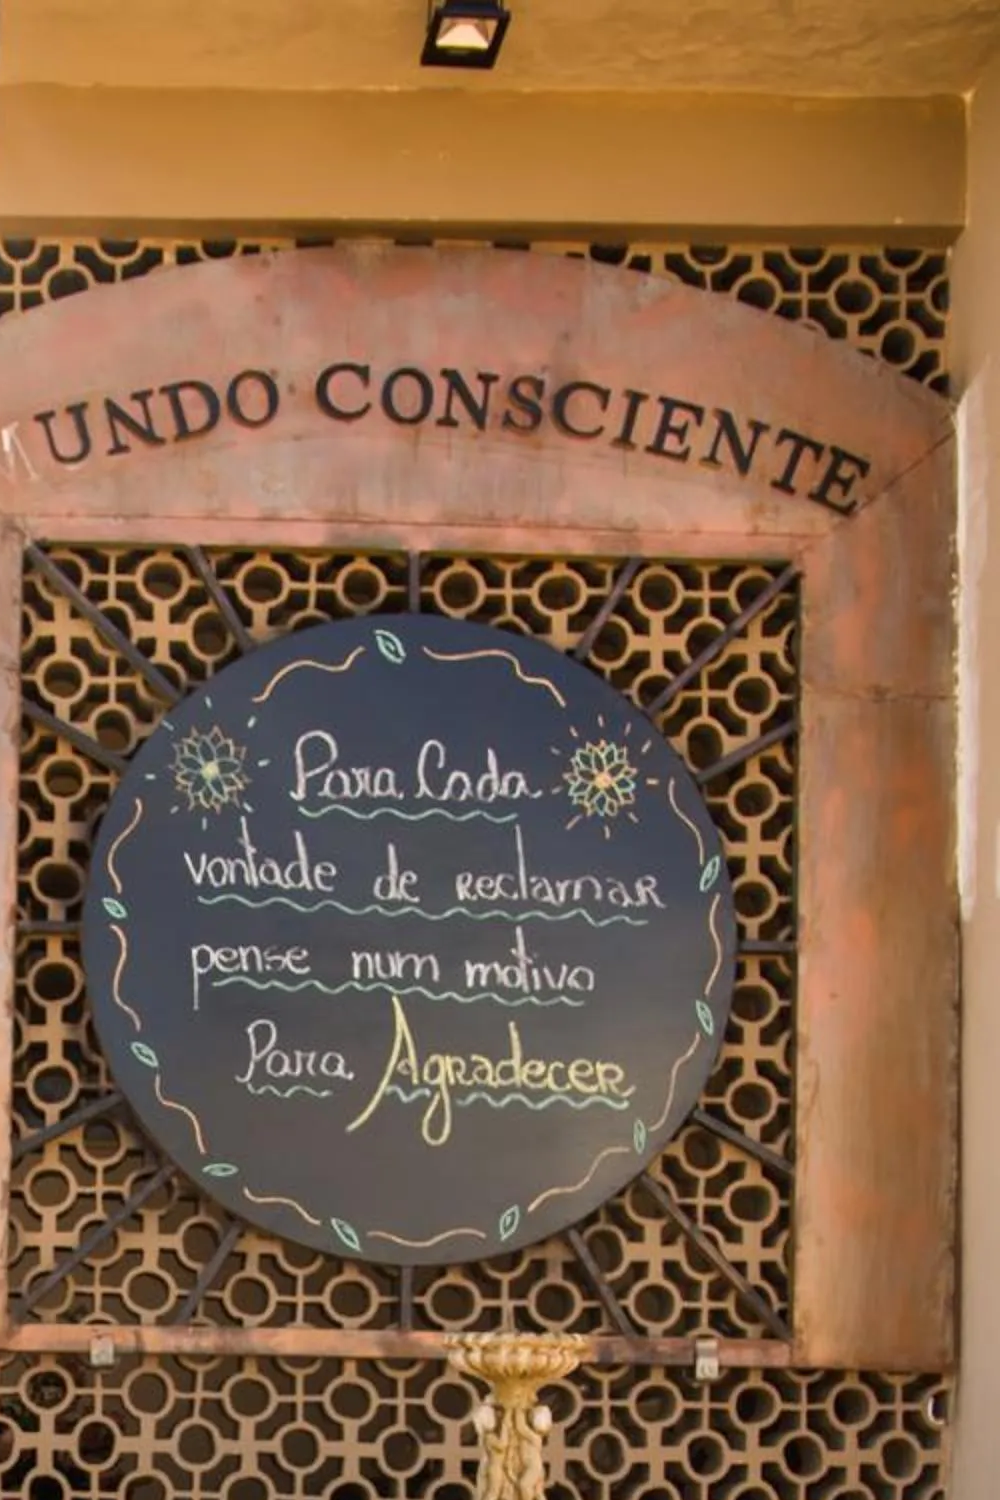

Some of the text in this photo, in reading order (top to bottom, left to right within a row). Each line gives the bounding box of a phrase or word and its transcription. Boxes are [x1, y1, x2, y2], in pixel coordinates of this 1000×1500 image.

[314, 362, 872, 516] CONSCIENTE
[290, 730, 543, 803] Para Cada
[184, 816, 338, 892] vontade
[373, 844, 420, 903] de
[191, 925, 595, 1011] pense num motivo
[236, 1019, 355, 1084] Para
